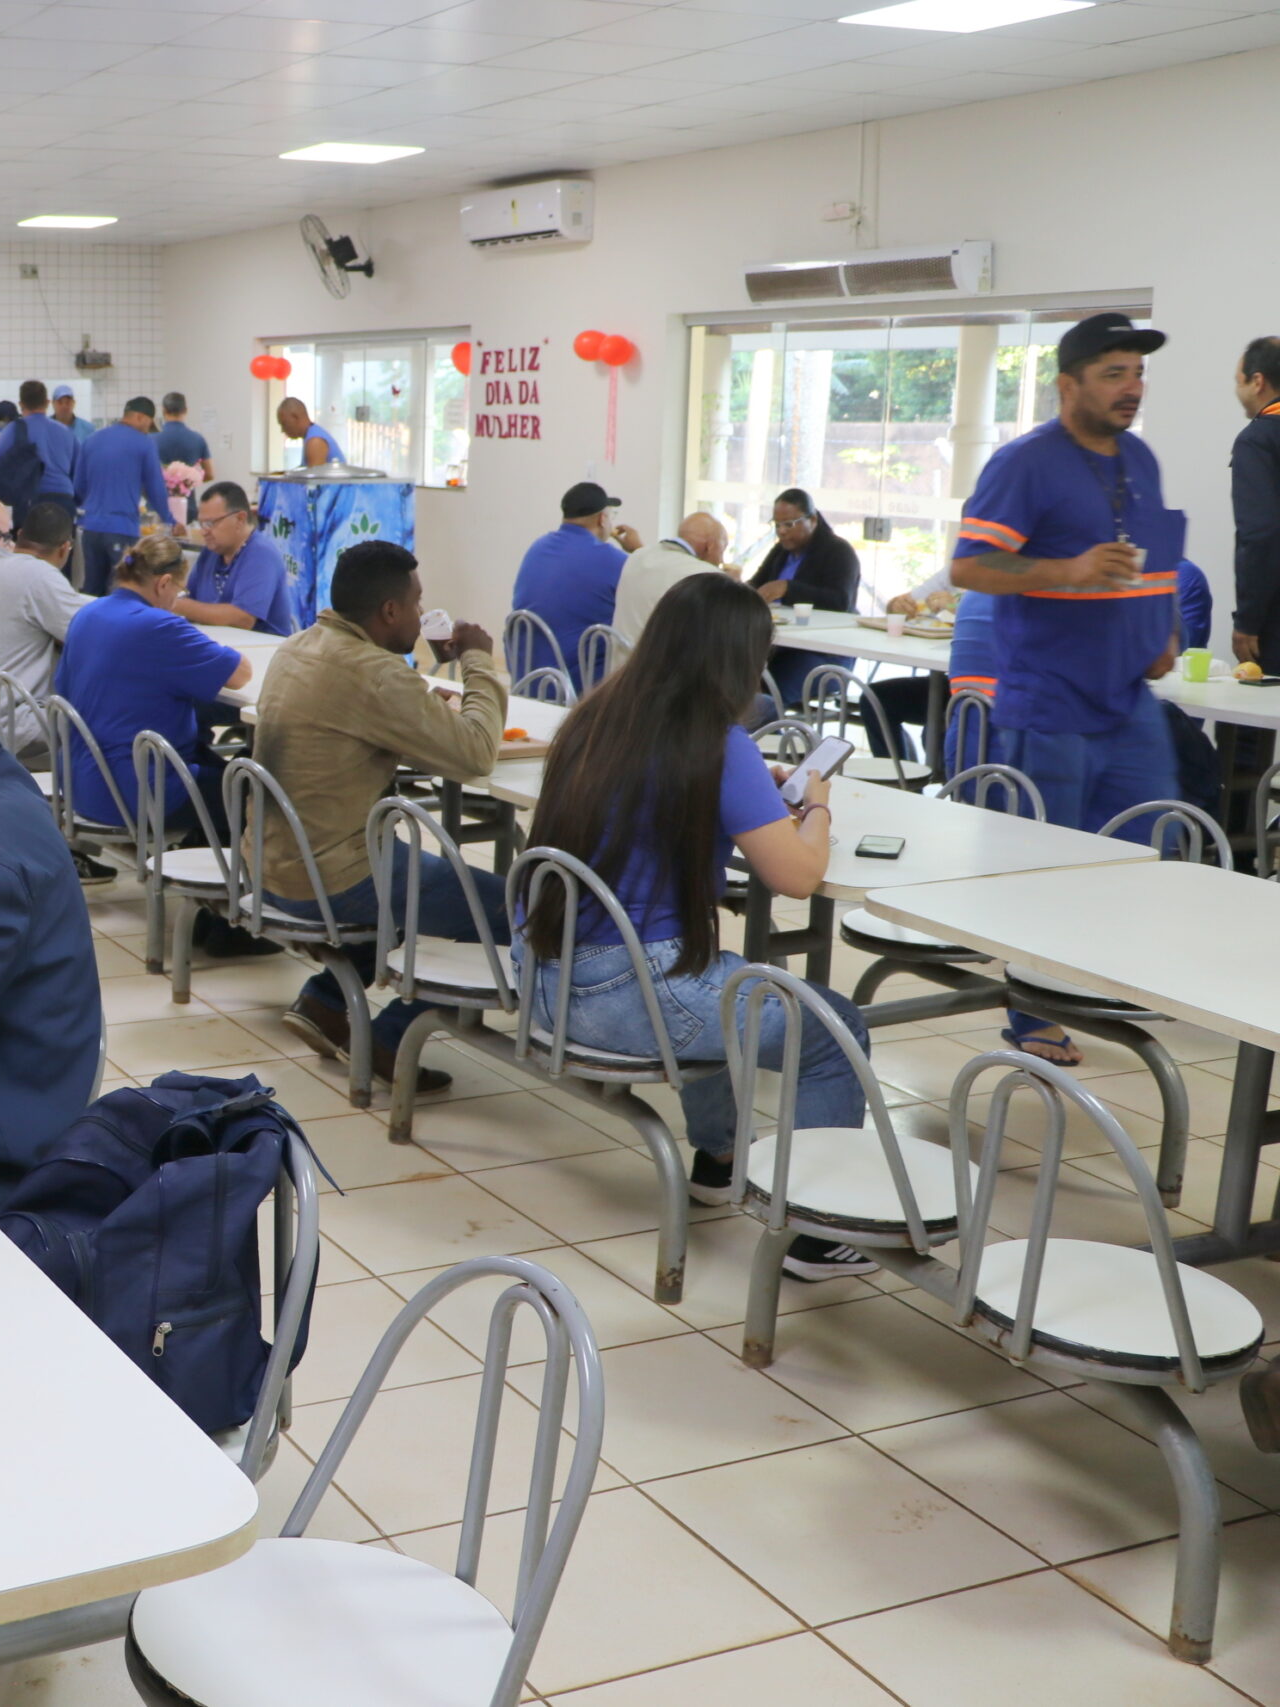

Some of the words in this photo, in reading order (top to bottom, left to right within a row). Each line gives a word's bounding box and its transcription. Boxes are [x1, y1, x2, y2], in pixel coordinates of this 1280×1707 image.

[480, 347, 541, 374] FELIZ
[486, 381, 513, 405] DIA
[518, 380, 540, 404] DA
[475, 413, 541, 439] MULHER
